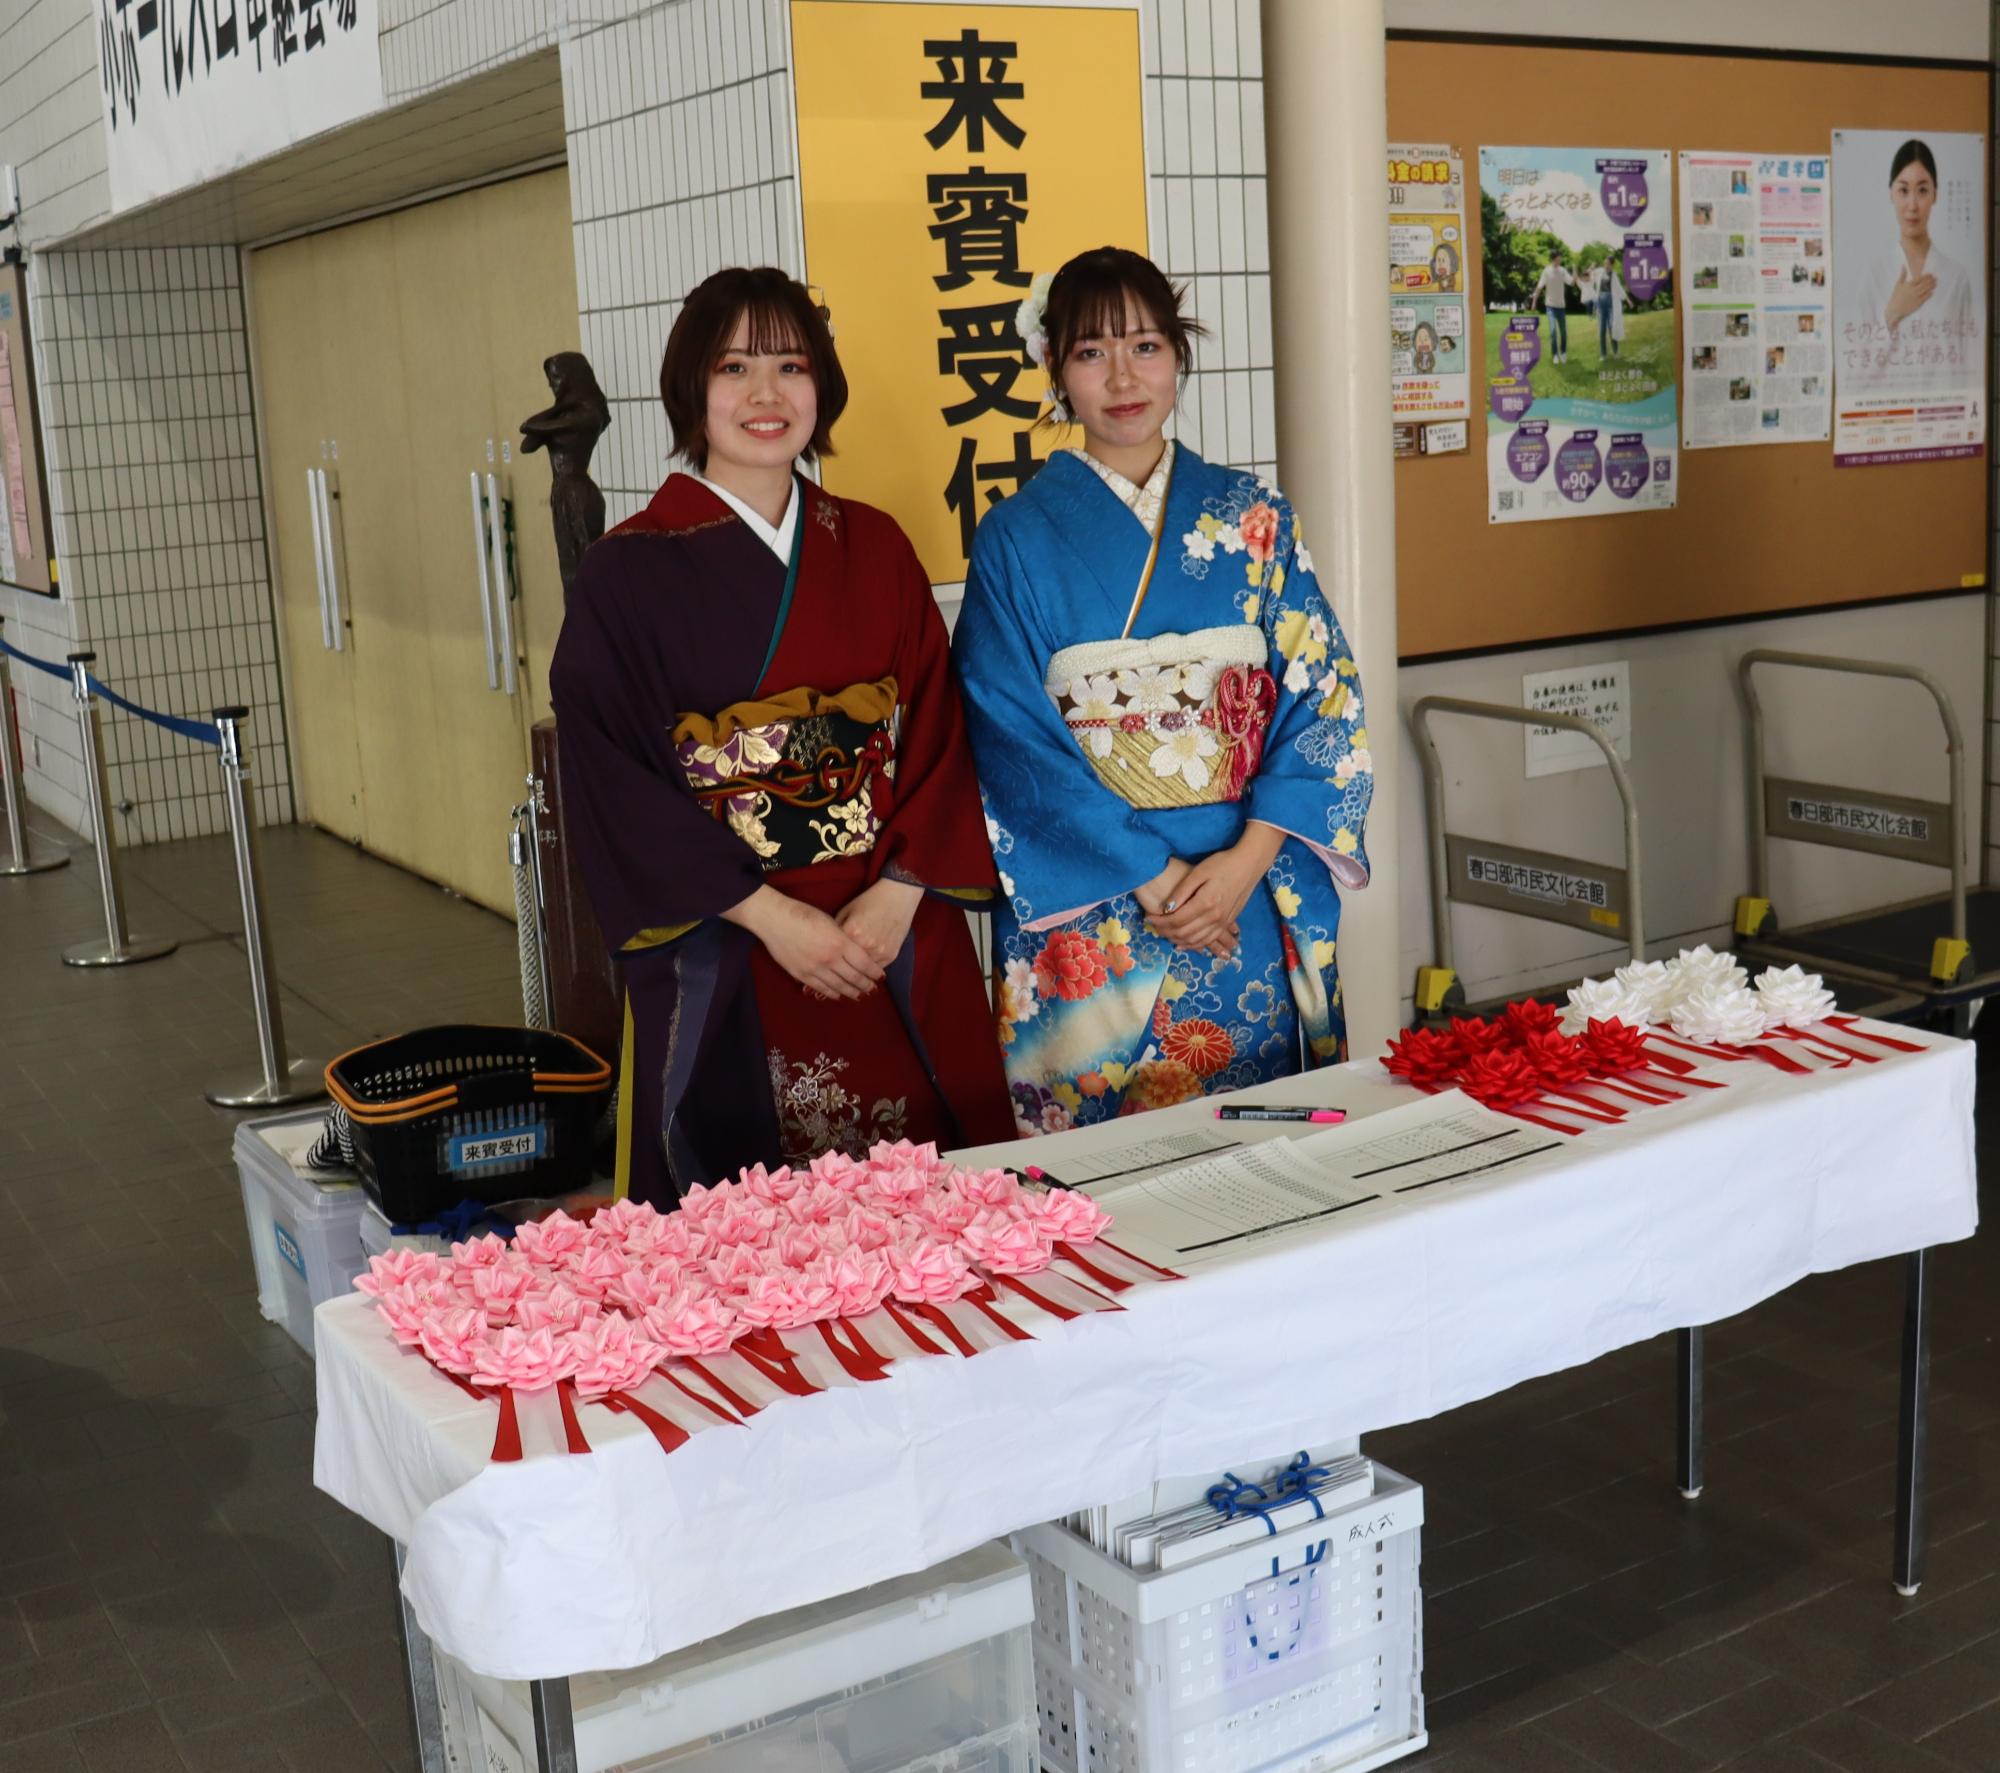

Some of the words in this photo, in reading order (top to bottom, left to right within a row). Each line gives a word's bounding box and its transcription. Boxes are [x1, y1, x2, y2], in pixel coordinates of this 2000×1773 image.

[1497, 168, 1541, 186] 明日は
[1499, 192, 1593, 211] もっとよくなる
[920, 28, 1046, 561] 来賓受付
[1788, 799, 1927, 840] 春日部市民文化会館
[1469, 858, 1605, 906] 春日部市民文化会館
[464, 1136, 532, 1161] 来賓受付
[1348, 1511, 1396, 1543] 成人式
